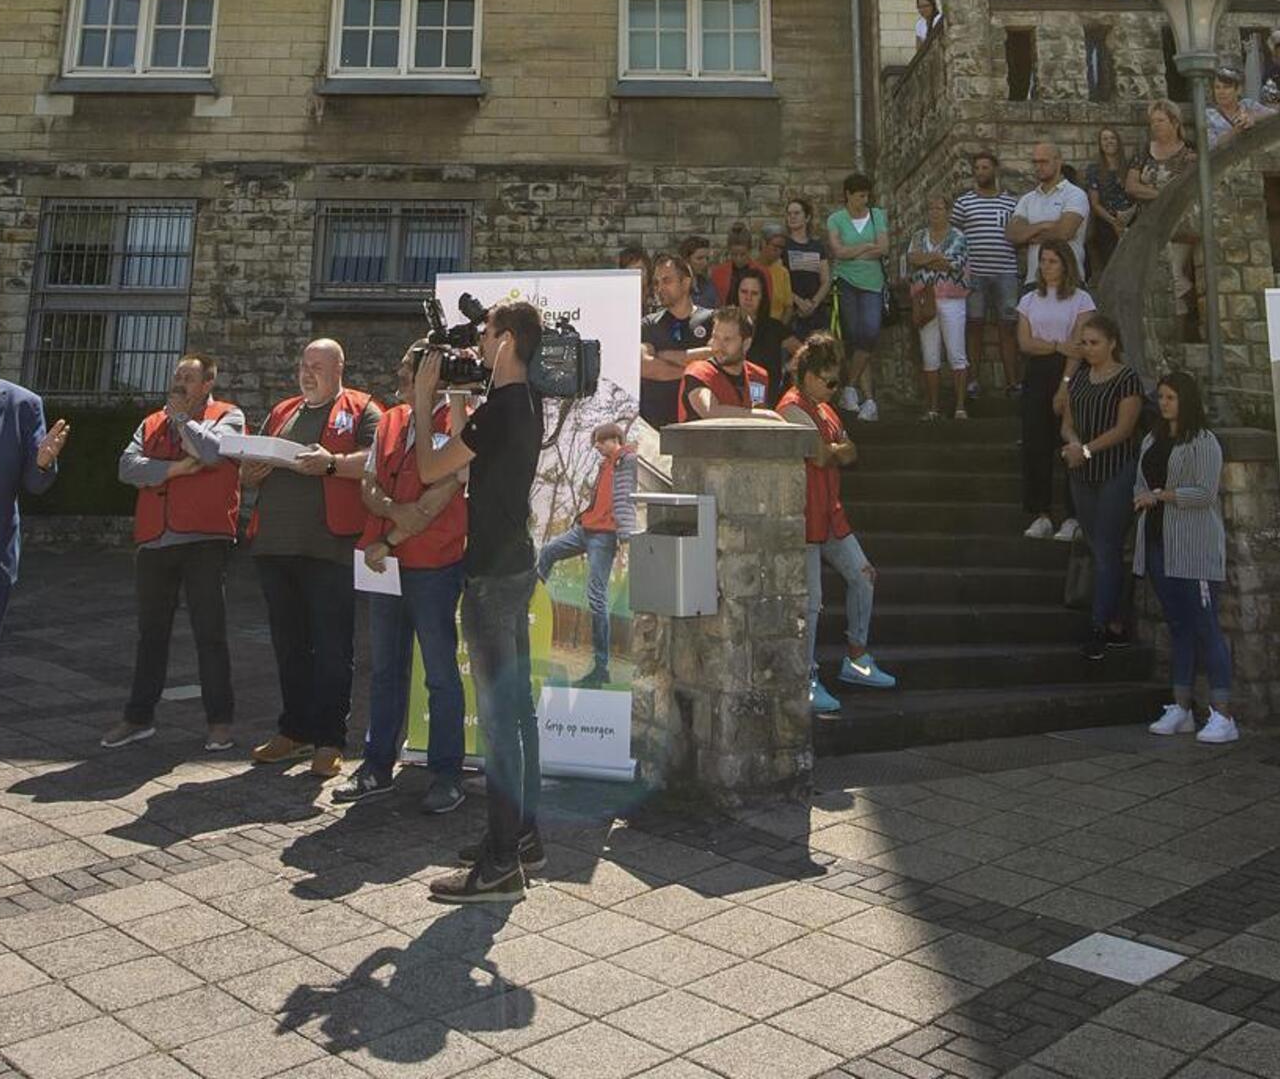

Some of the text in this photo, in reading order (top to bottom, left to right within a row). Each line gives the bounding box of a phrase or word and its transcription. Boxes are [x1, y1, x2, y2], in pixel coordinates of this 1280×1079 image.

[545, 719, 615, 739] Grip op morgen
